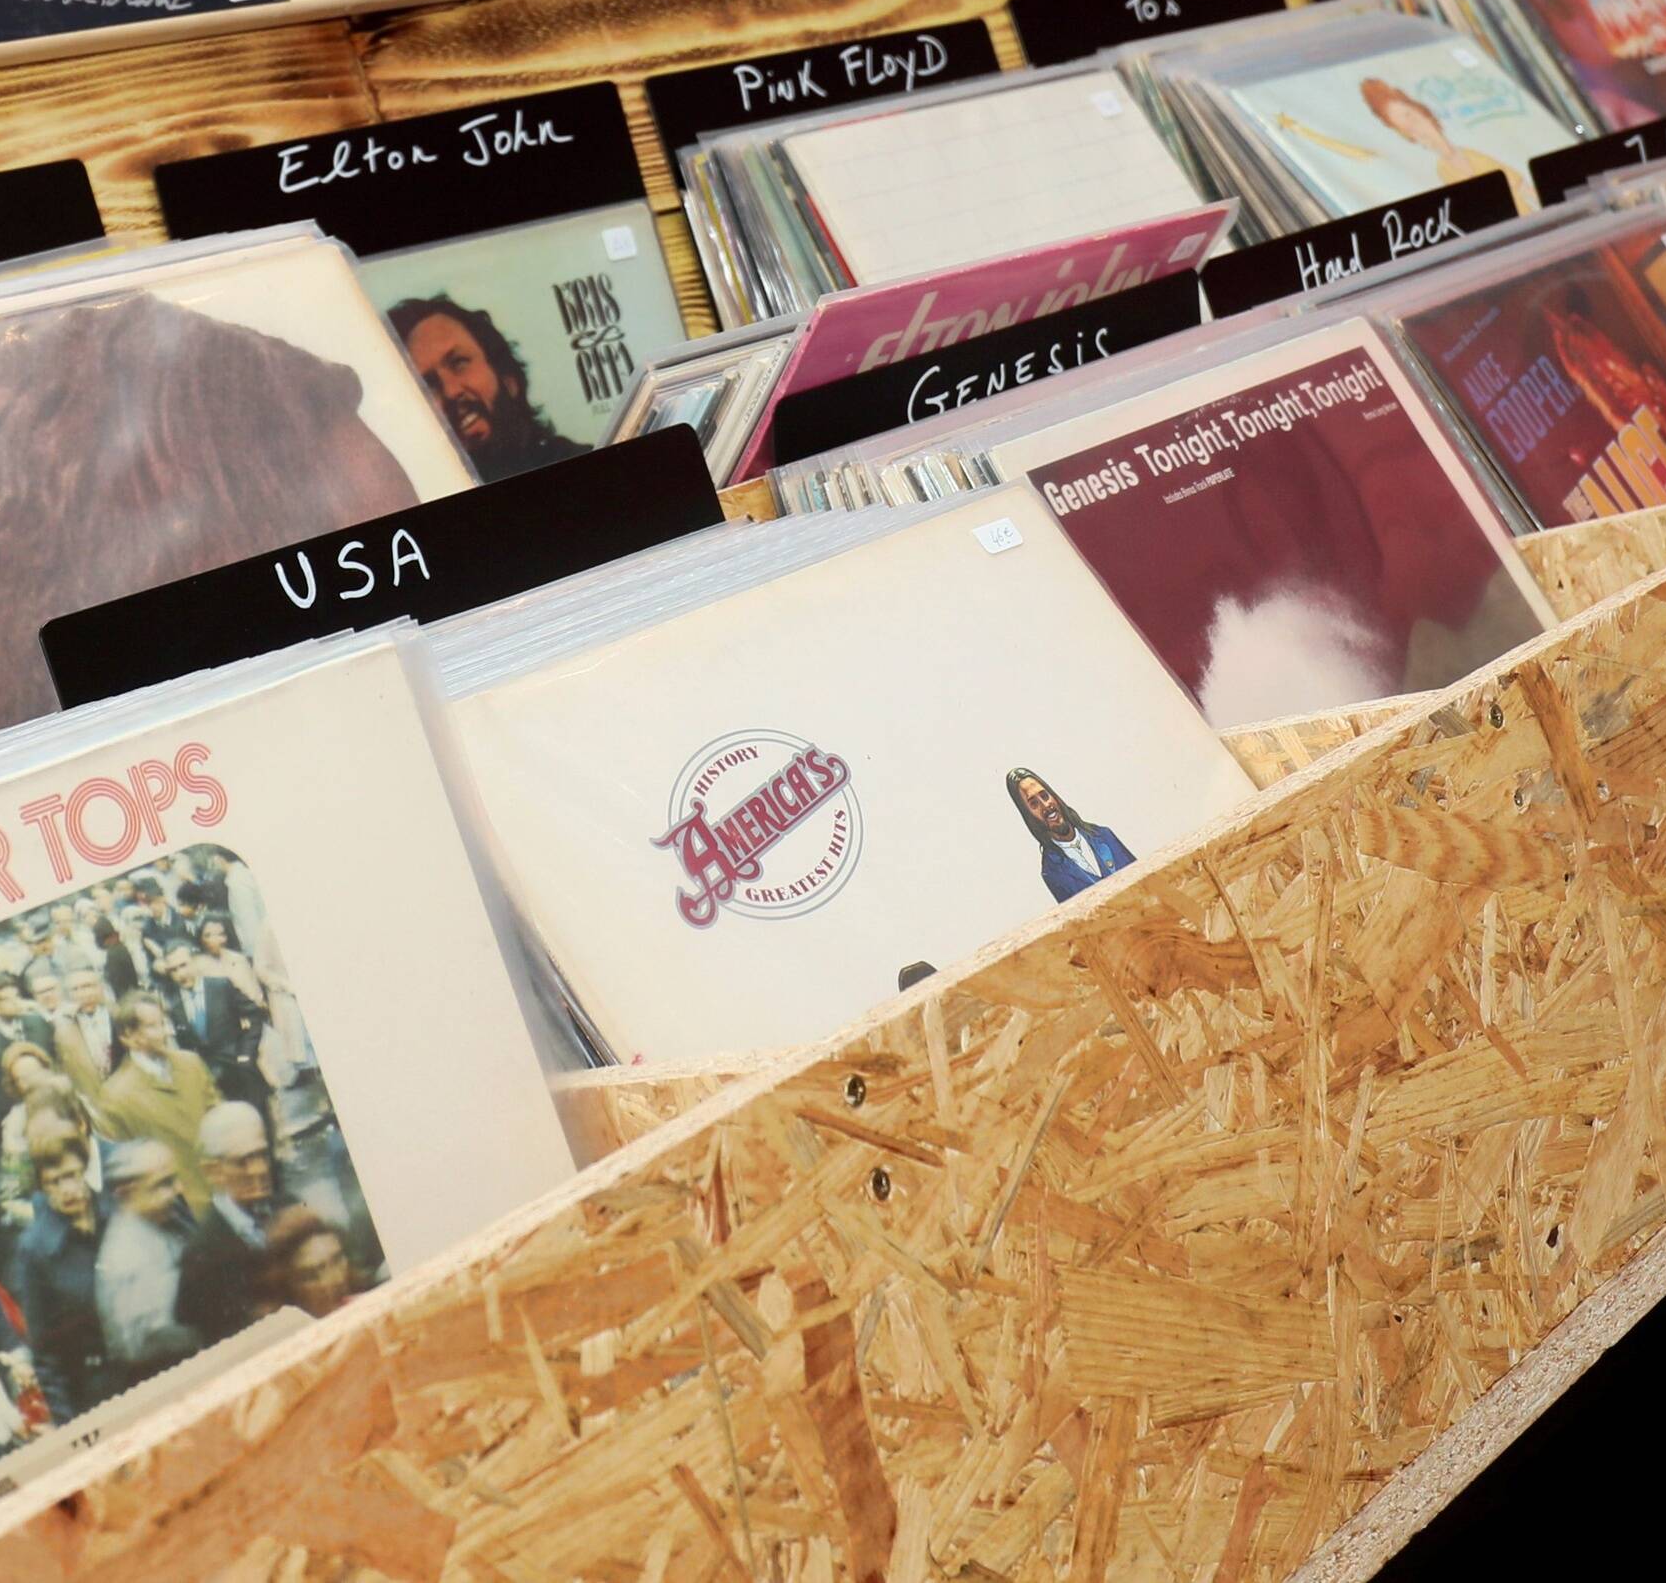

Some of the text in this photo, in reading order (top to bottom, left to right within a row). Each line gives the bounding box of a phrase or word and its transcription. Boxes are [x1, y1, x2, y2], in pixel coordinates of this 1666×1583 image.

[276, 110, 575, 195] Elton John
[551, 272, 622, 335] KRIS
[1042, 458, 1141, 518] Genesis
[274, 526, 432, 612] USA
[19, 742, 229, 885] TOPS
[693, 744, 761, 798] HISTORY
[744, 807, 848, 904] GREATEST HITS
